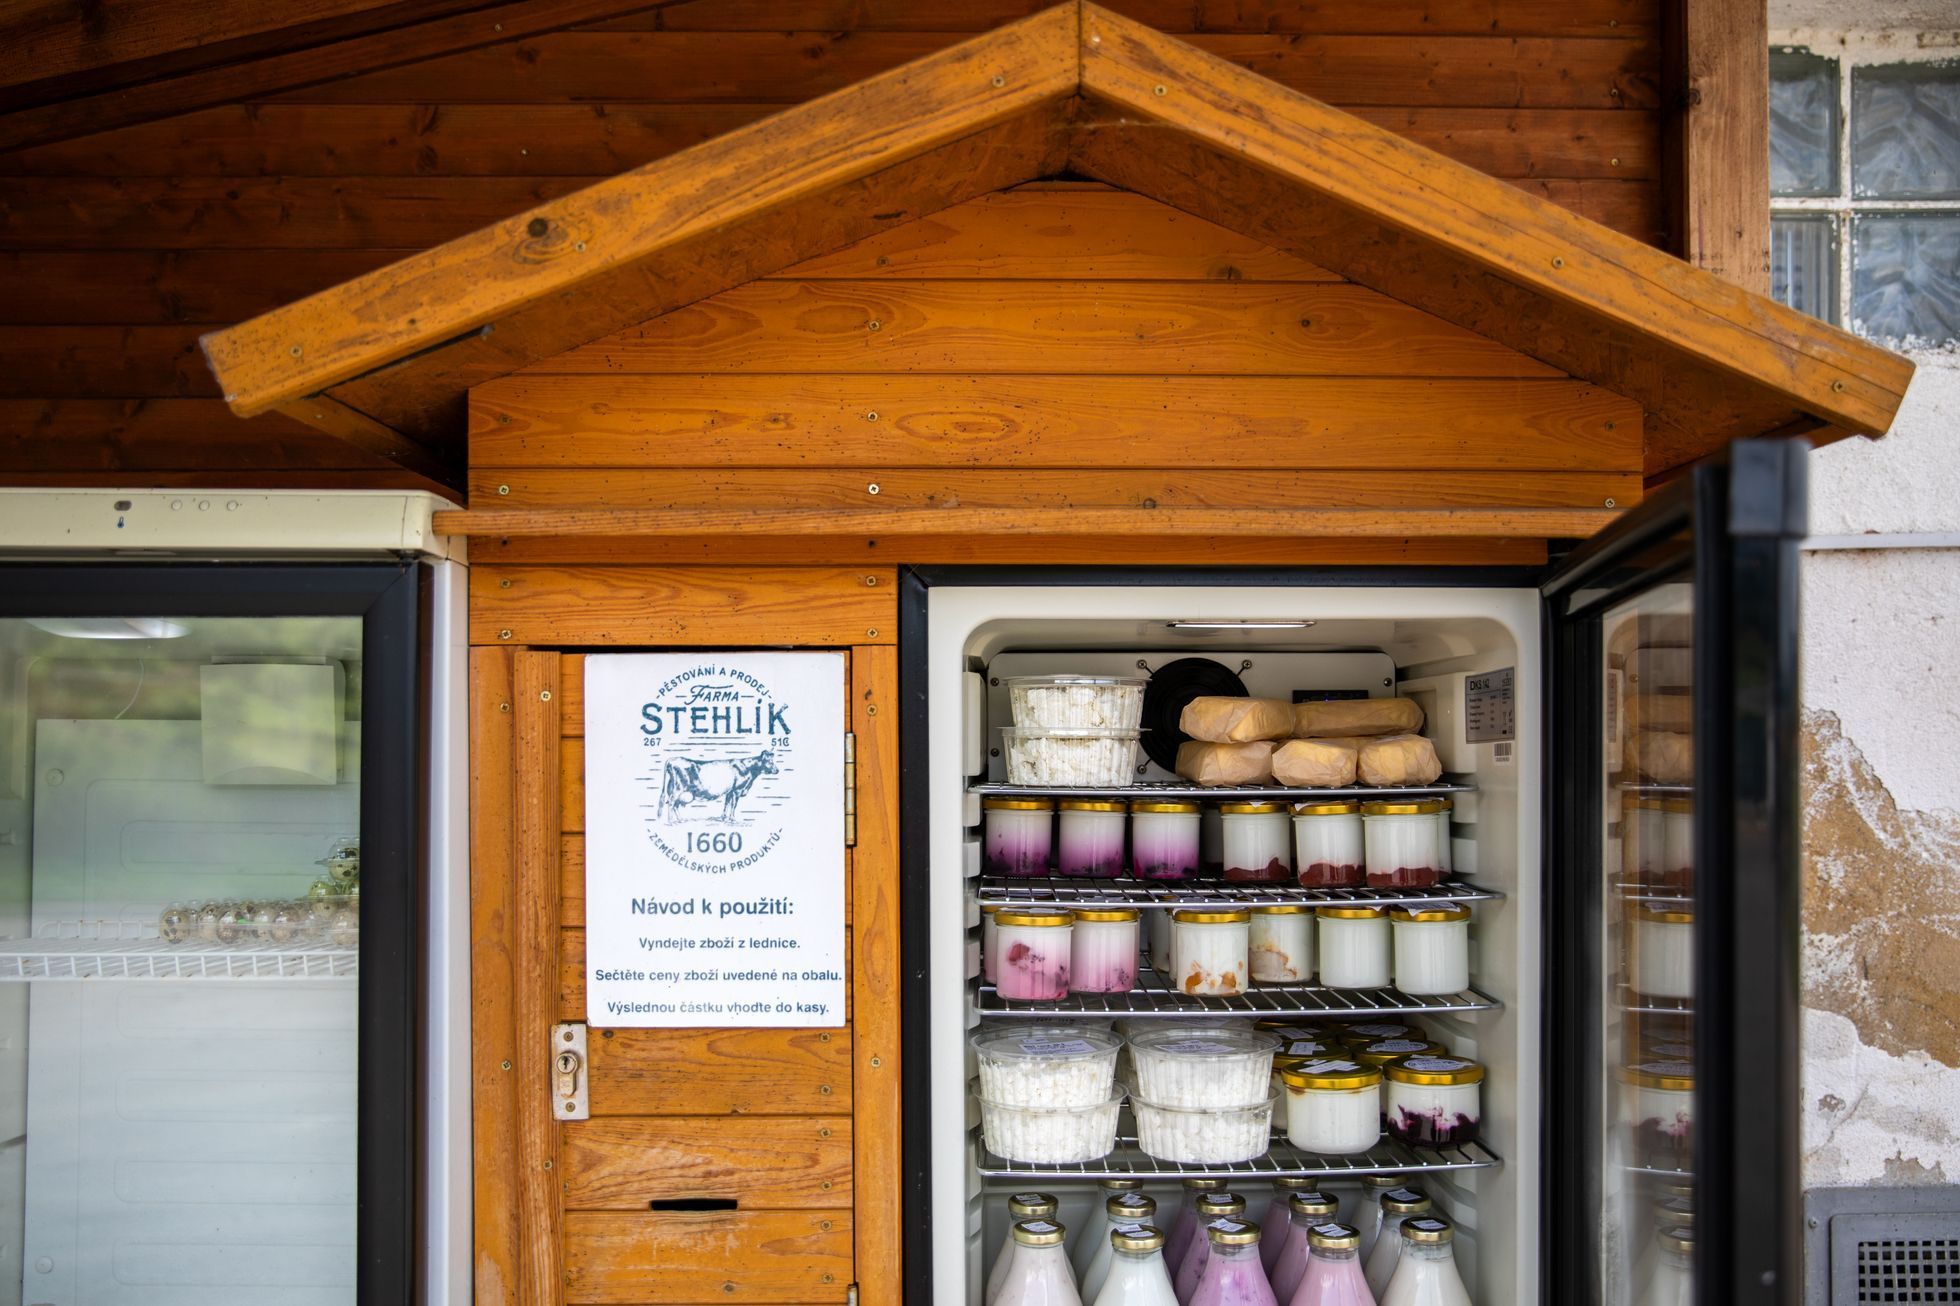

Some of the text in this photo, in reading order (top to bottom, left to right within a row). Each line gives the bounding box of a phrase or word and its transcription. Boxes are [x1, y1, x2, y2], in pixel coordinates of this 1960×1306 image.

[719, 667, 727, 677] A
[730, 669, 769, 696] PRODEJ
[684, 684, 740, 705] FARMA
[640, 698, 791, 735] STEHLÍK
[643, 737, 662, 747] 267
[687, 832, 743, 853] 1660
[631, 897, 794, 919] Návod k použití:
[639, 937, 800, 951] Vyndejte zboží z lednice.
[595, 969, 842, 984] Sečtěte ceny zboží uvedené na obalu.
[607, 1001, 675, 1015] Výslednou
[680, 1001, 723, 1013] částku
[775, 1001, 793, 1013] do
[796, 1001, 830, 1016] kasy.
